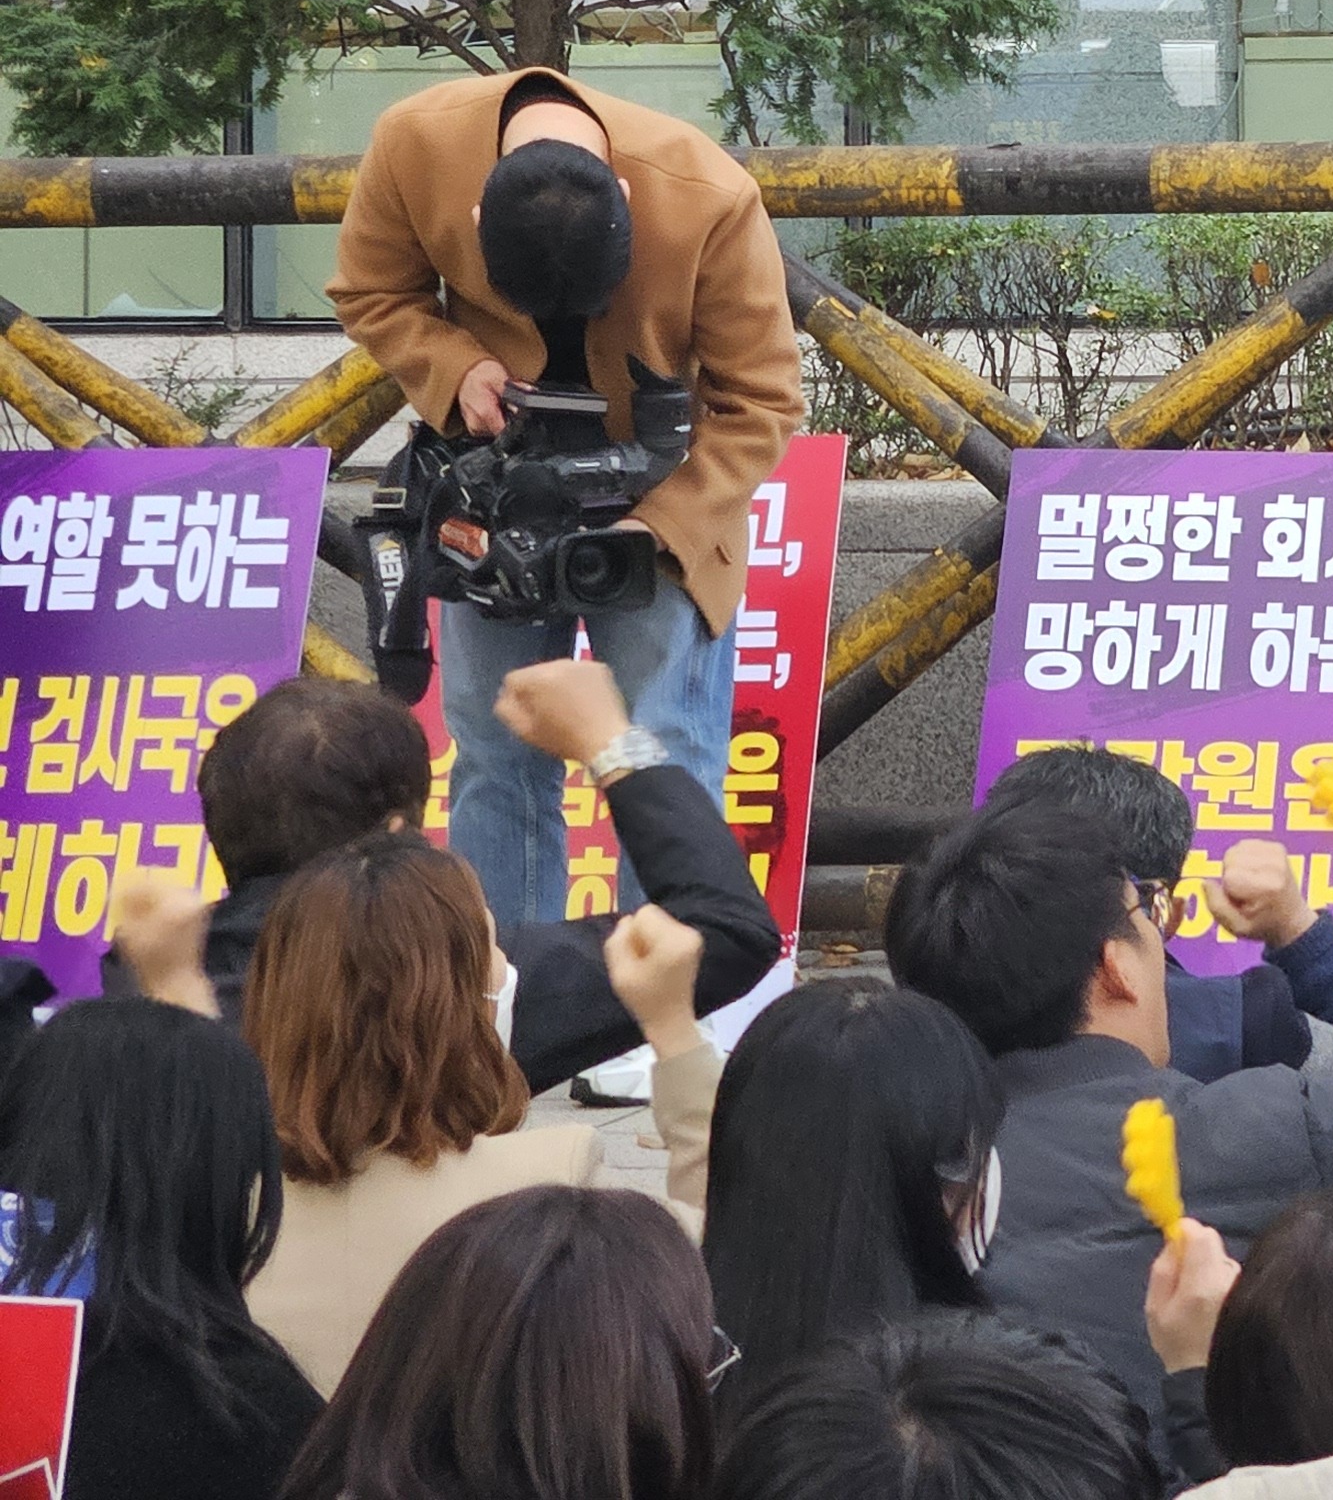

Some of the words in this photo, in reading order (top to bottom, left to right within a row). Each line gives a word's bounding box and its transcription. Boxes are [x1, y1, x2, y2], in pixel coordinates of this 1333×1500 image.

[0, 492, 114, 612] 역할
[115, 491, 290, 610] 못하는
[1037, 493, 1242, 581] 멀쩡한
[1024, 600, 1228, 690] 망하게
